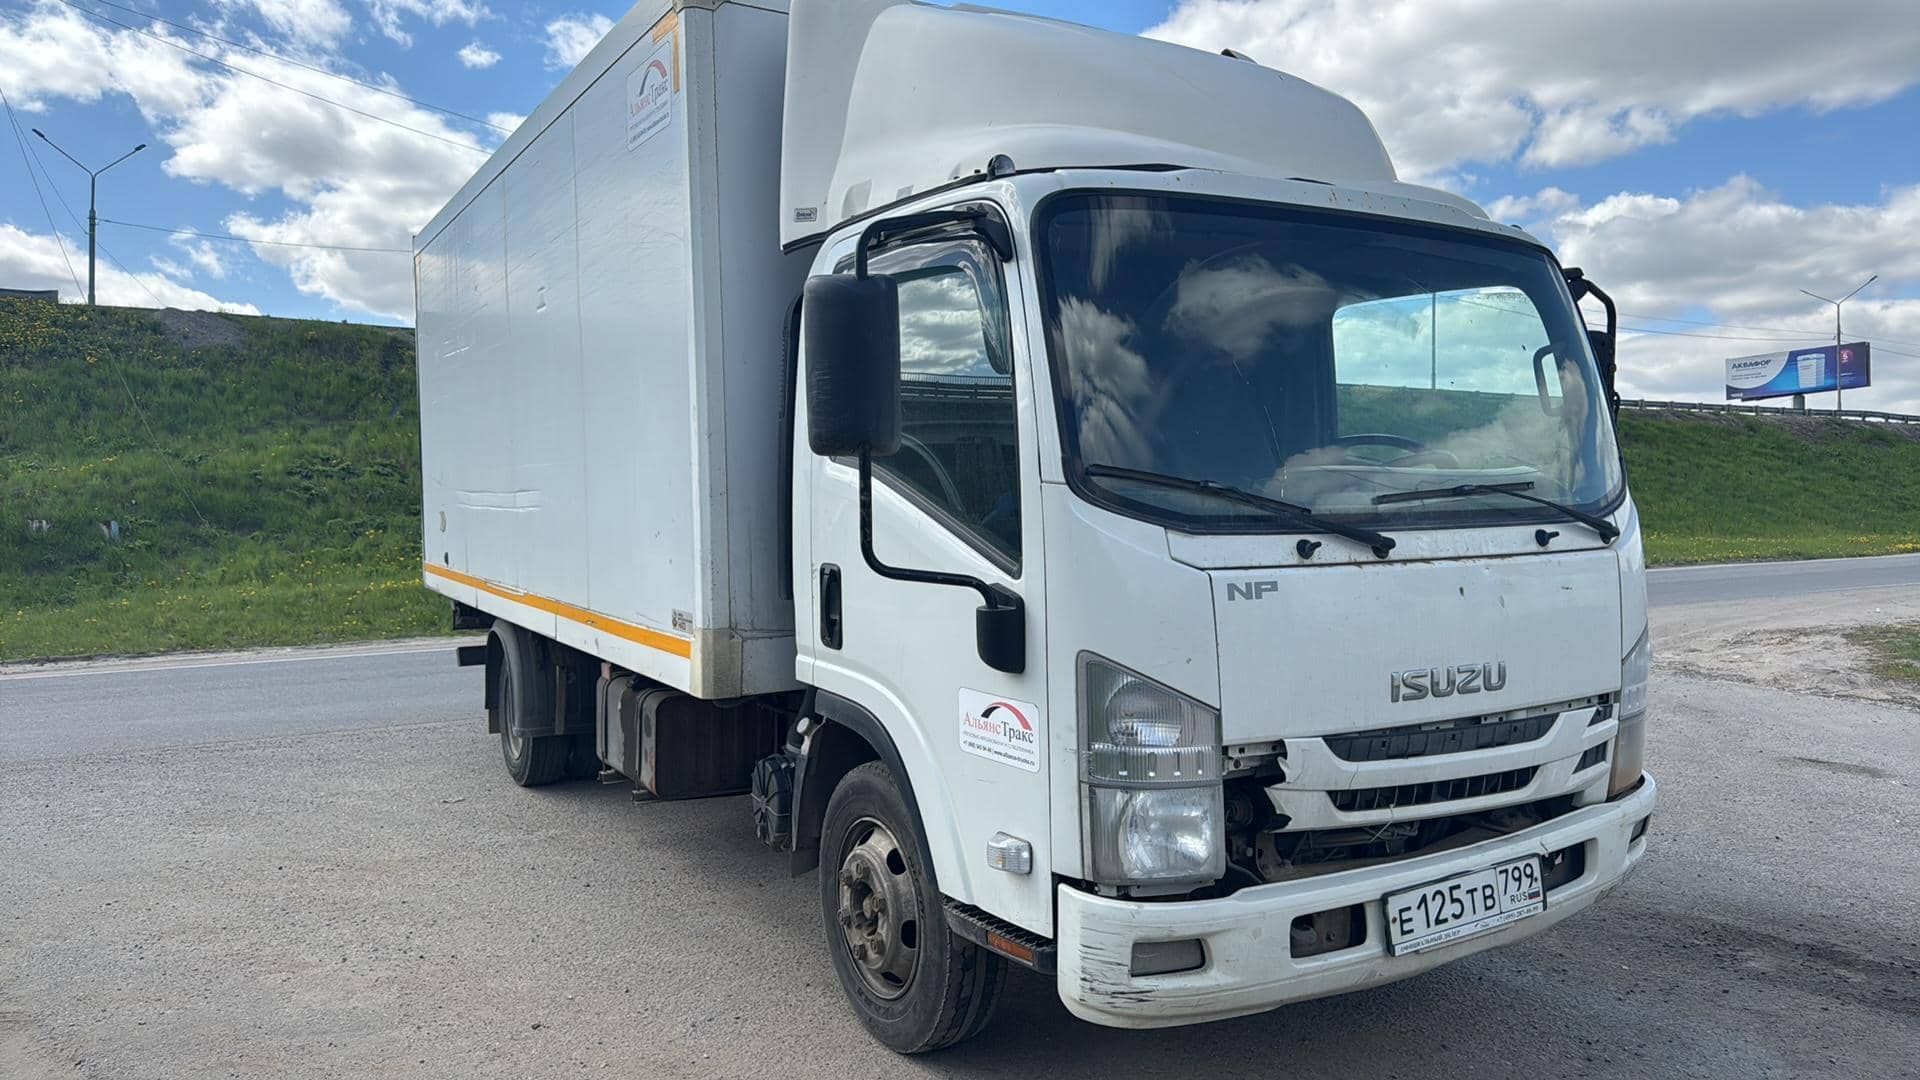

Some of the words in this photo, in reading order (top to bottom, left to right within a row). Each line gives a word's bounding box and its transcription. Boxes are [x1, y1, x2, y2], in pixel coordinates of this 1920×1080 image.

[1731, 359, 1772, 369] АКВАФОР
[1226, 580, 1279, 601] NP
[1390, 660, 1507, 703] ISUZU
[963, 711, 1034, 744] АльянсТракс
[1498, 862, 1535, 896] 799
[1510, 890, 1528, 905] RUS
